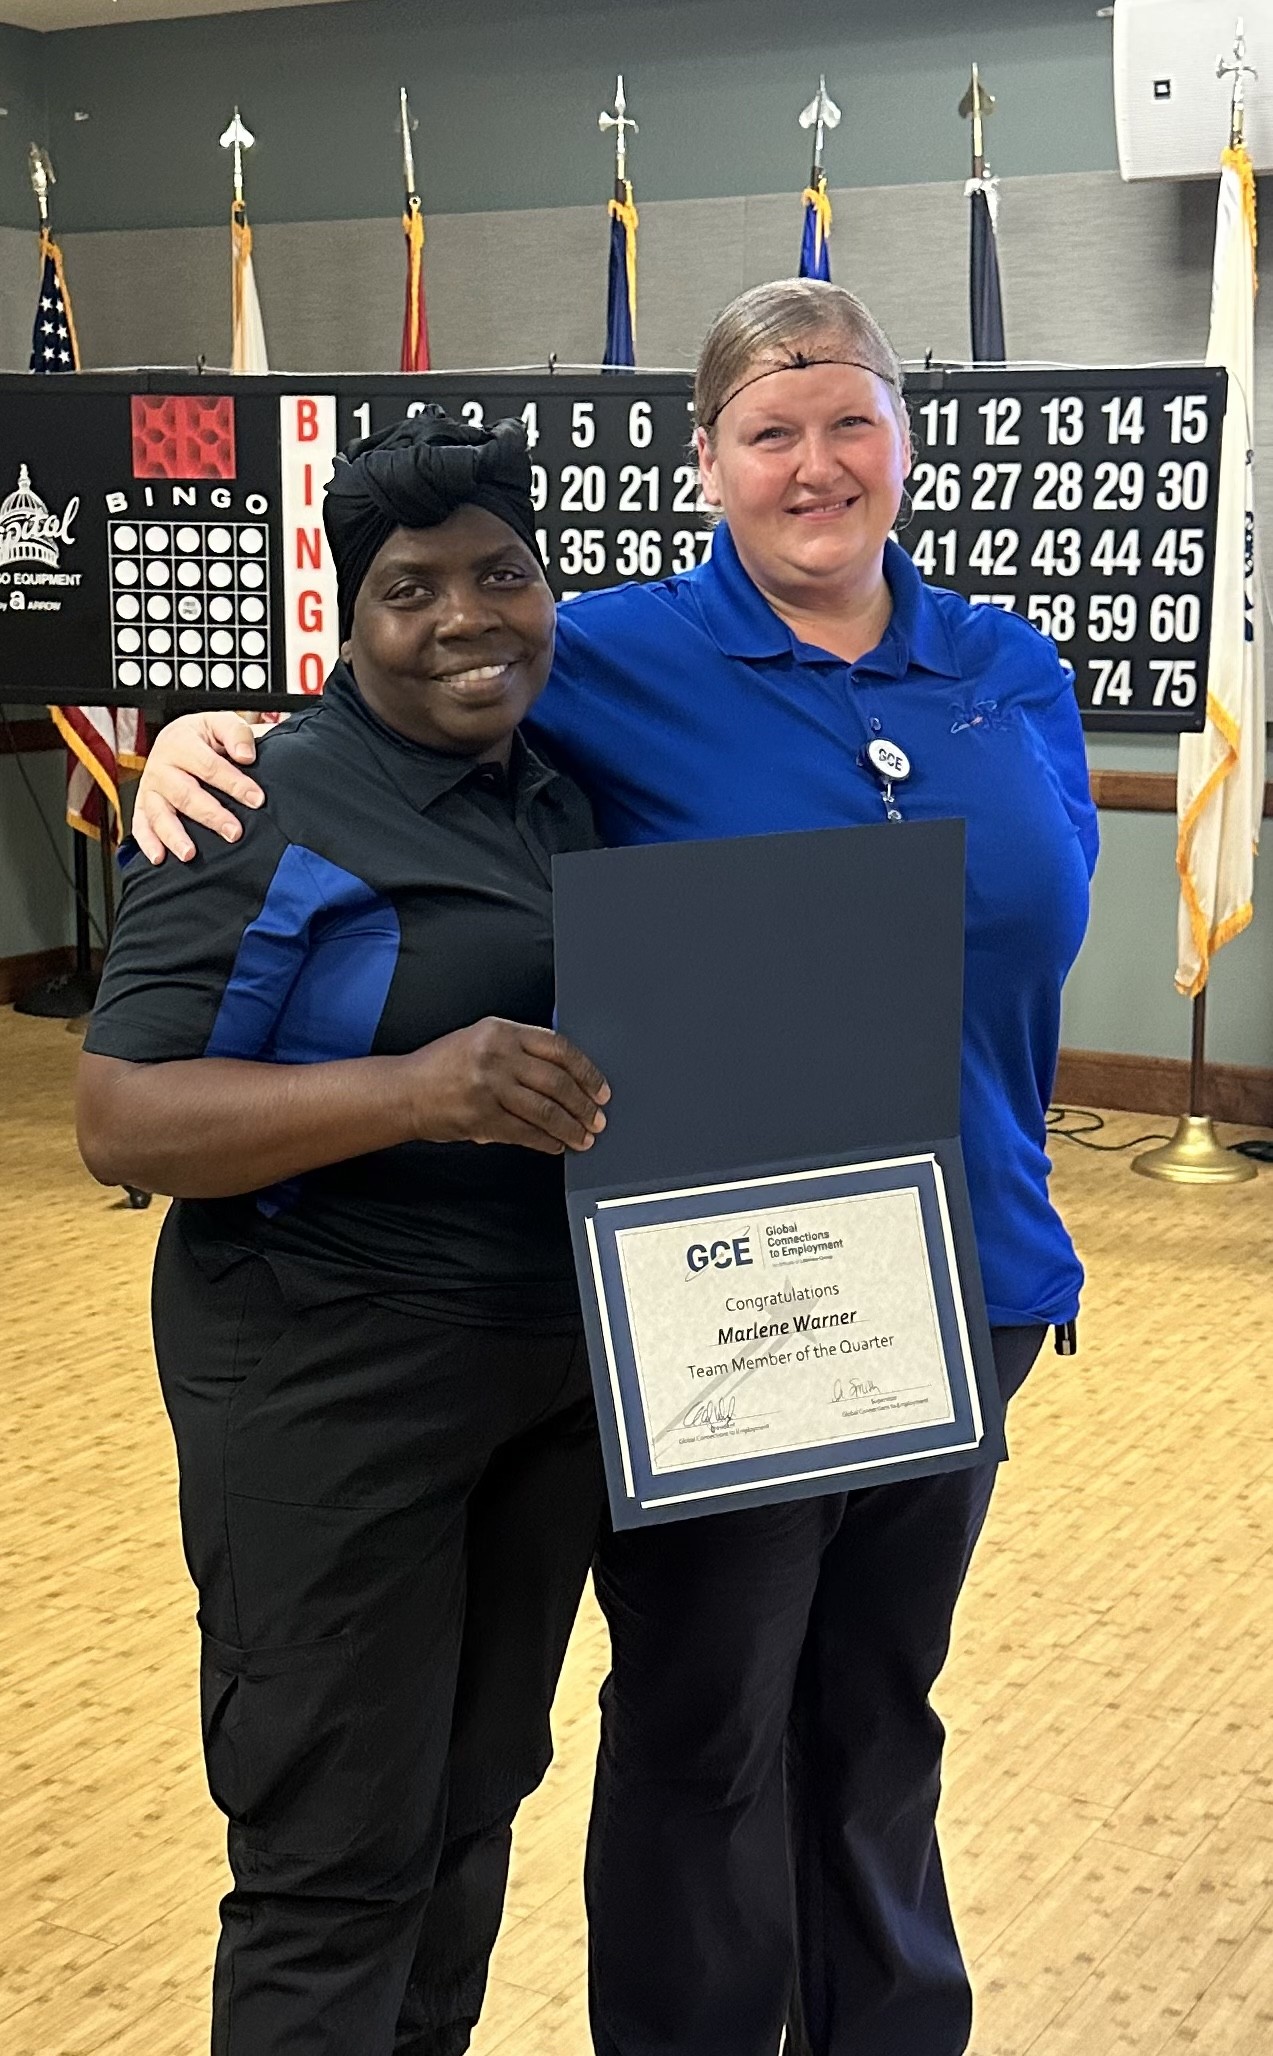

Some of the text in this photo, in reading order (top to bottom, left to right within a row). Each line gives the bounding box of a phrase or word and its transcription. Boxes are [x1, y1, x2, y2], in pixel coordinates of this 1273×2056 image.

[353, 402, 370, 440] 1
[521, 402, 540, 447] 4
[571, 403, 595, 448] 5
[629, 402, 653, 448] 6
[919, 399, 959, 446] 11
[978, 397, 1022, 446] 12
[1040, 396, 1084, 446] 13
[1101, 396, 1145, 445] 14
[1163, 395, 1208, 444] 15
[106, 486, 269, 514] BINGO
[531, 465, 548, 512] 9
[560, 465, 606, 512] 20
[618, 466, 660, 512] 21
[911, 463, 961, 511] 26
[971, 462, 1022, 511] 27
[1032, 461, 1083, 511] 28
[1093, 461, 1144, 511] 29
[1156, 461, 1209, 511] 30
[297, 399, 325, 695] BINGO
[560, 529, 606, 575] 35
[615, 529, 662, 576] 36
[672, 530, 714, 573] 37
[911, 529, 958, 576] 41
[968, 528, 1019, 576] 42
[1030, 528, 1081, 577] 43
[1090, 528, 1142, 576] 44
[1152, 528, 1205, 577] 45
[13, 572, 82, 586] EQUIPMENT
[1027, 593, 1200, 642] 58 59 60
[1088, 660, 1197, 707] 74 75
[878, 748, 902, 772] GCE
[765, 1222, 798, 1236] Global
[767, 1231, 830, 1247] Connections
[687, 1237, 753, 1272] GCE
[769, 1239, 843, 1259] to Employment
[725, 1283, 840, 1312] Congratulations
[718, 1309, 857, 1345] Marlene Warner
[688, 1334, 895, 1379] Team Member of the Quarter
